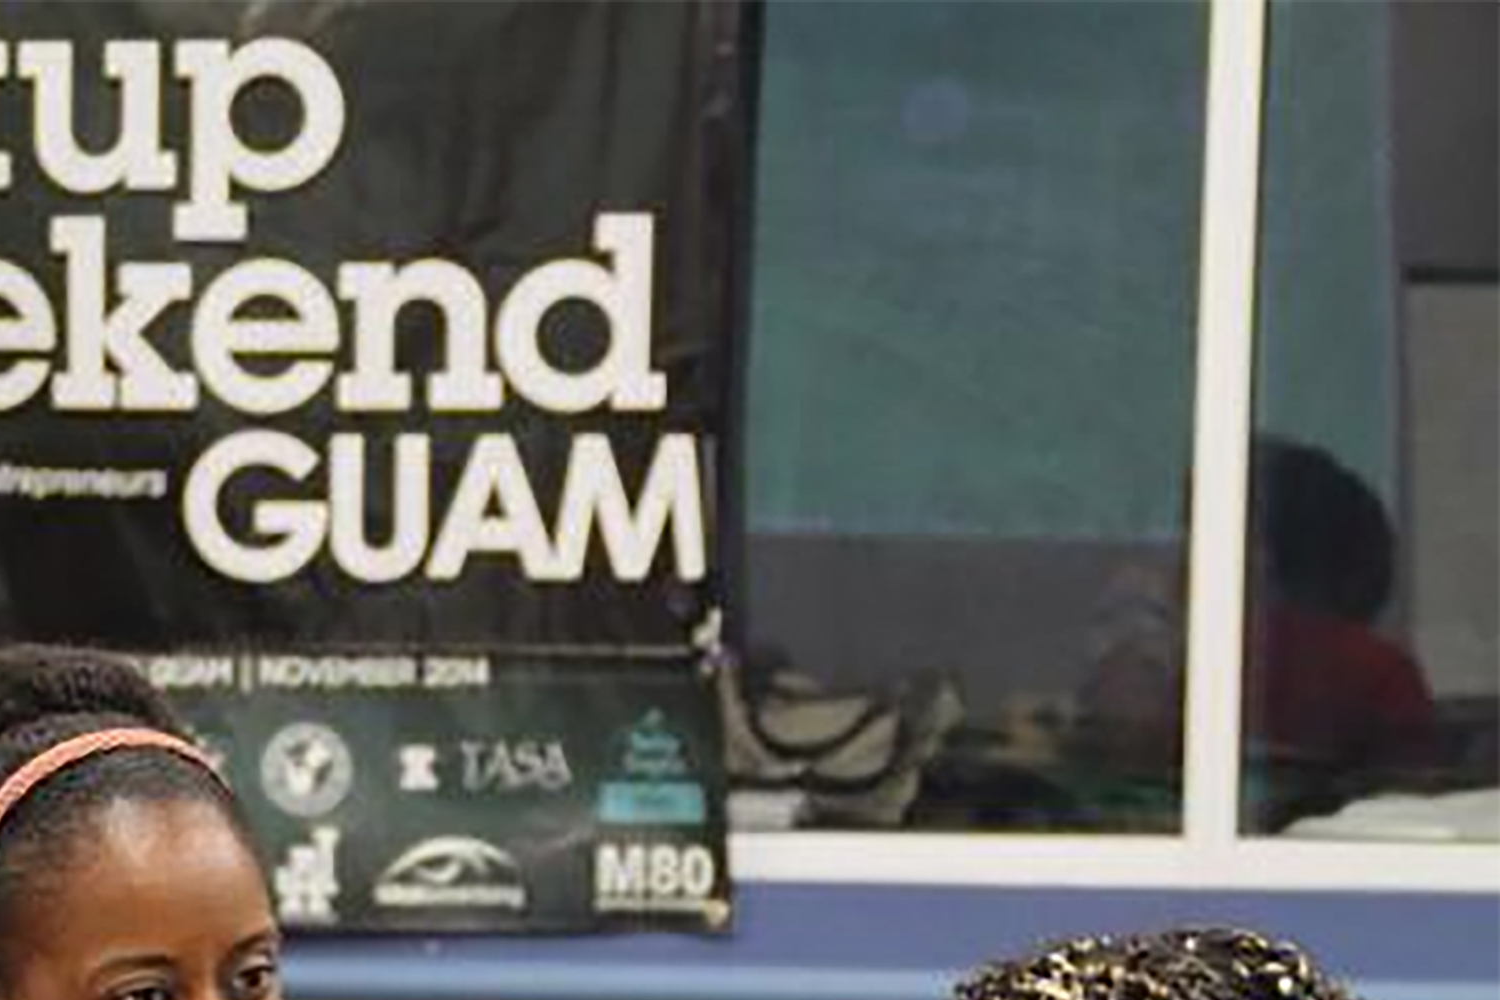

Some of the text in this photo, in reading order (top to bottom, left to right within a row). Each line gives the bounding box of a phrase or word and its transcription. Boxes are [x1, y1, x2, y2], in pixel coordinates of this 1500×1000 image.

[183, 429, 705, 583] GUAM
[258, 656, 416, 686] NOVEMBER
[423, 656, 490, 686] 2014
[460, 738, 572, 789] TASA
